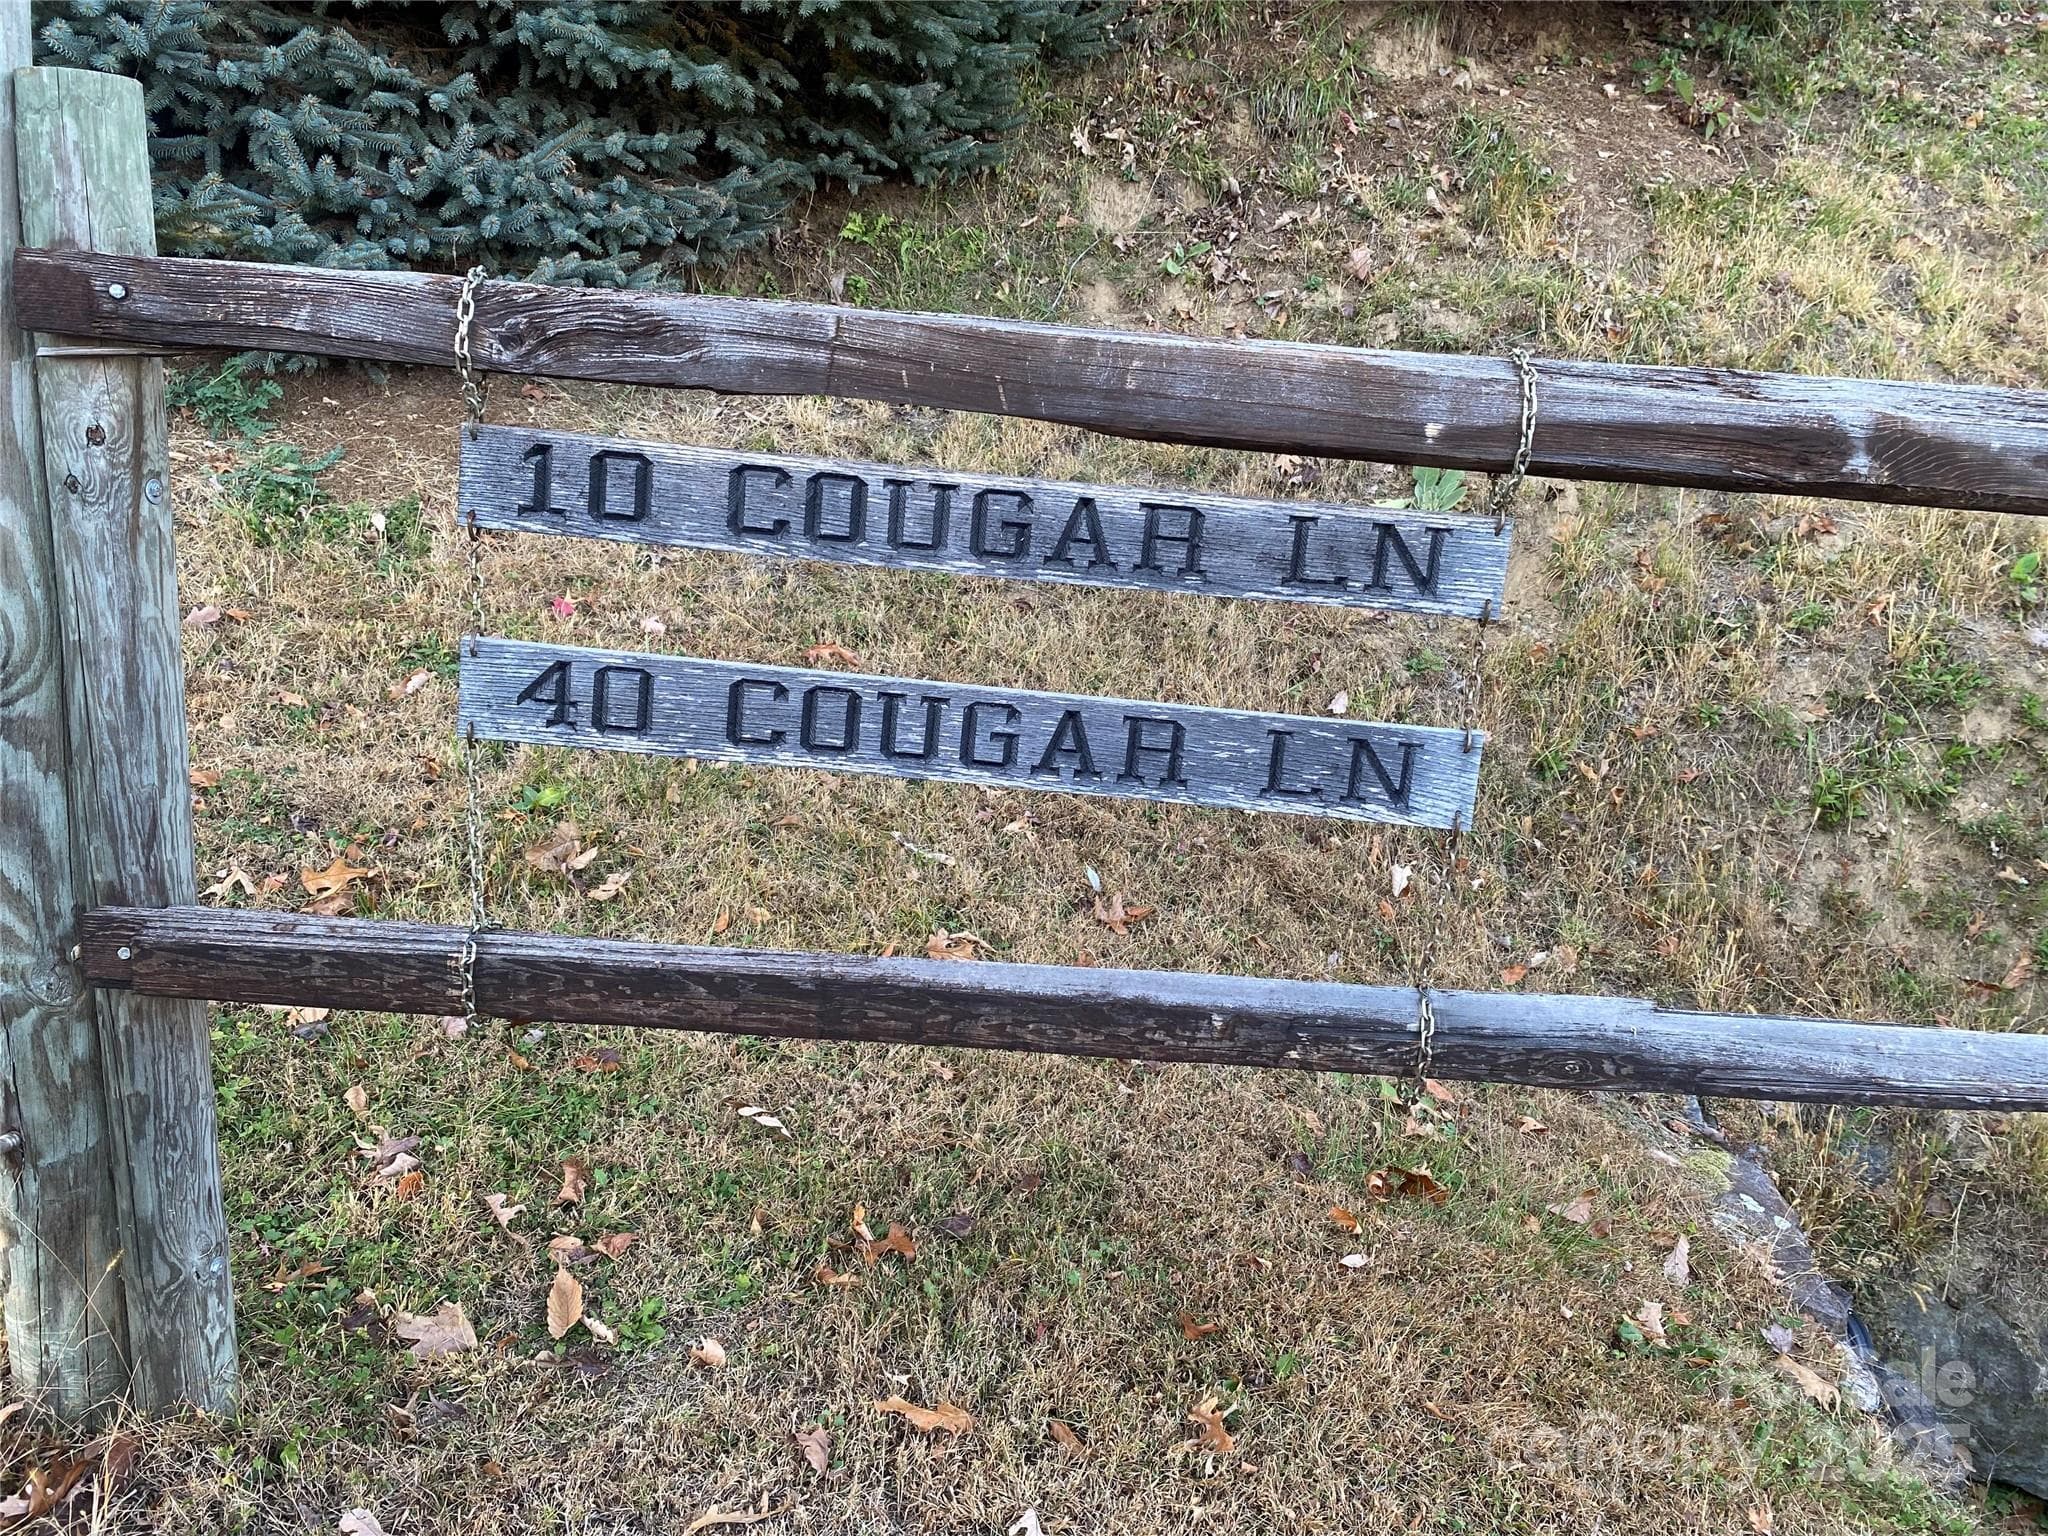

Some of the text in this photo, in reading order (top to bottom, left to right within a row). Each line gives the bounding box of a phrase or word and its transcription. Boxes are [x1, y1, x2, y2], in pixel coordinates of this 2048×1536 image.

[517, 443, 1454, 596] 10 COUGAR LN
[516, 660, 1425, 810] 40 COUGAR LN
